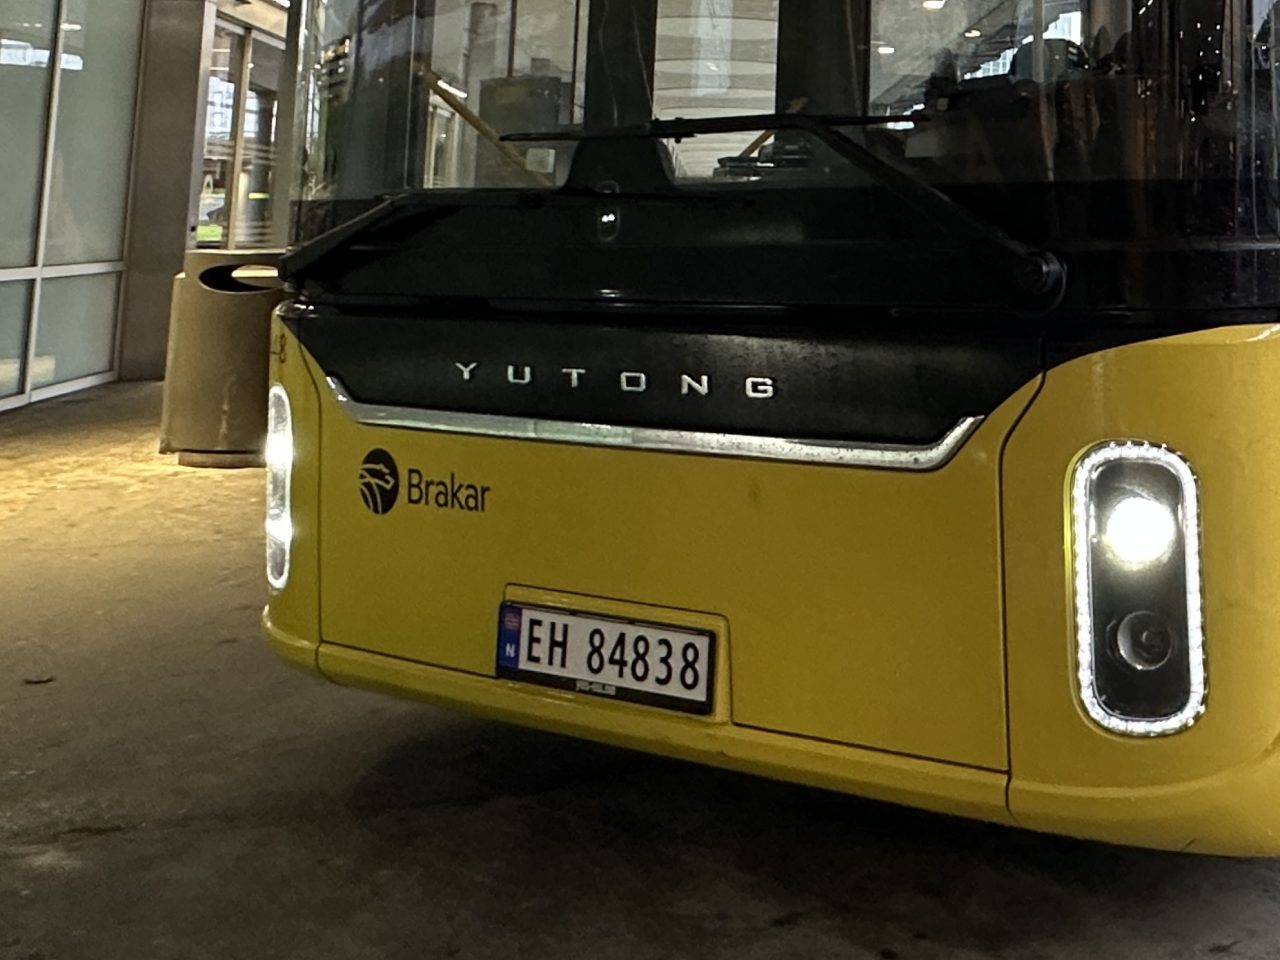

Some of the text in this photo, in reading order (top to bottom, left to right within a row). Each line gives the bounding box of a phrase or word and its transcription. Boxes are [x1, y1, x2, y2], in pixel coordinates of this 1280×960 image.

[455, 361, 776, 399] YUTONG
[407, 468, 491, 513] Brakar
[505, 642, 515, 658] N
[526, 618, 700, 690] EH 84838
